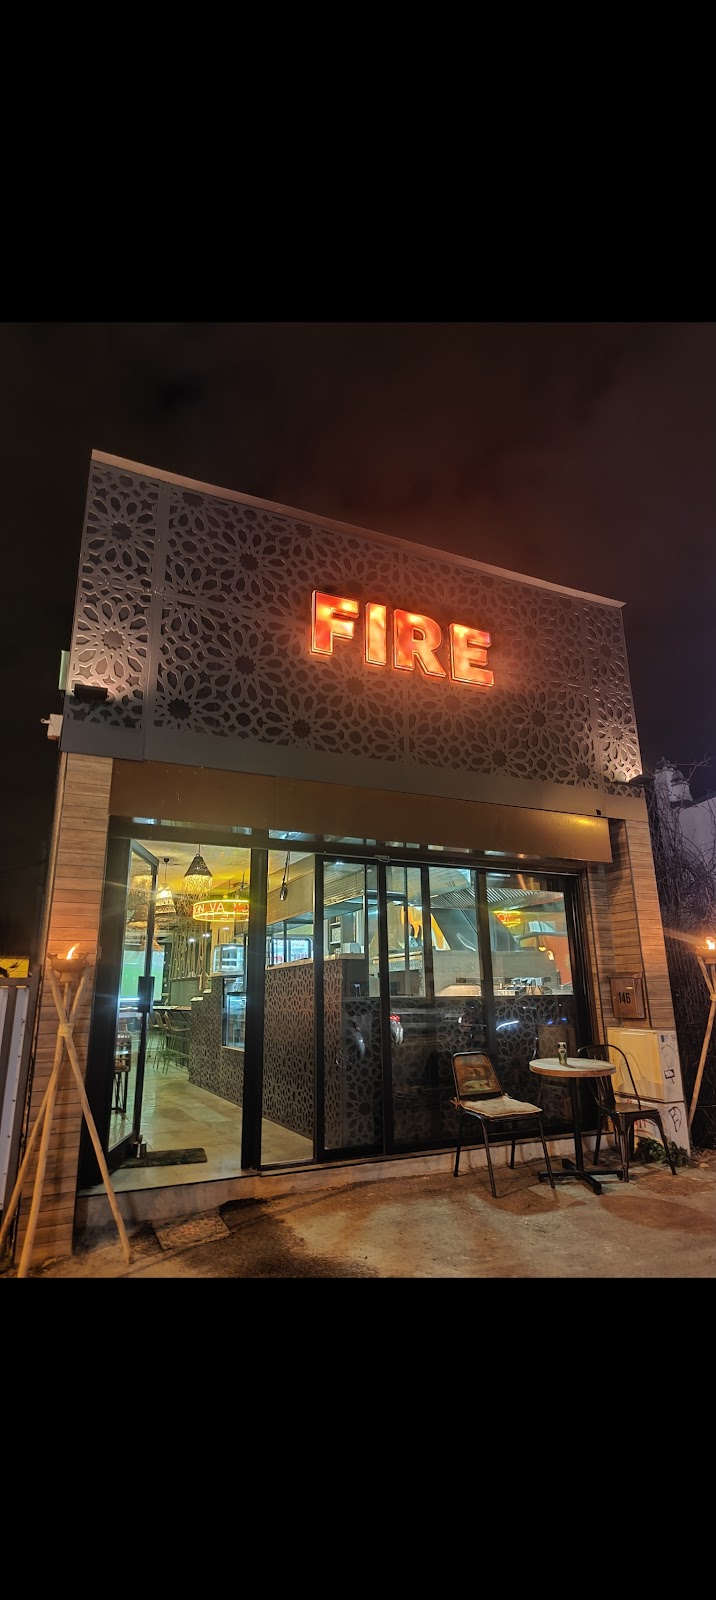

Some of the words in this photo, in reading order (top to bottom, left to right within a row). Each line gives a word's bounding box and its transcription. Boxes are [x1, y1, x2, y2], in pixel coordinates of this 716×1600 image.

[311, 589, 494, 687] FIRE
[209, 902, 225, 912] VA
[618, 991, 631, 1004] 146
